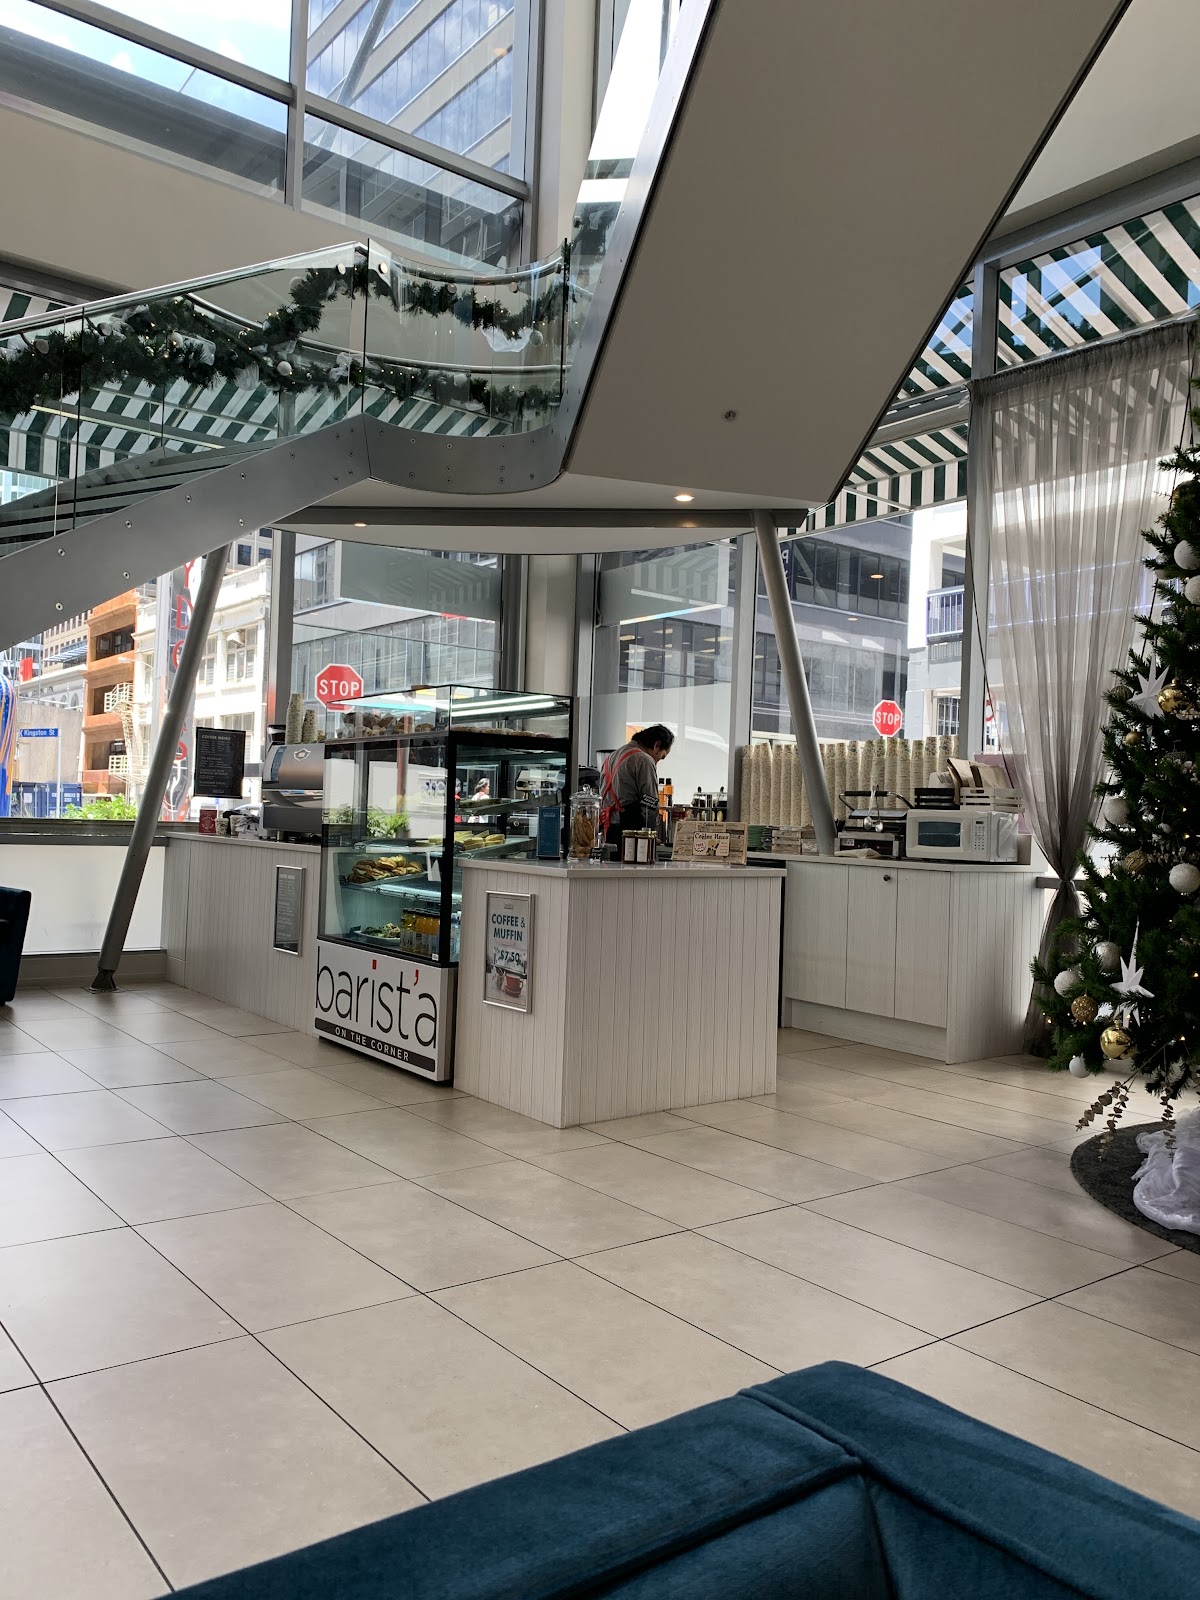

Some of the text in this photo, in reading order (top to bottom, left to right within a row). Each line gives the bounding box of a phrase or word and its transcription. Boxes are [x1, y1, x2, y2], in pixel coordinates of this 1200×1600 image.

[319, 679, 360, 697] STOP
[875, 711, 900, 726] STOP
[24, 729, 47, 737] Kingston
[491, 913, 526, 929] COFFEE &
[493, 927, 523, 941] MUFFIN
[334, 1026, 409, 1062] ON THE CORNER
